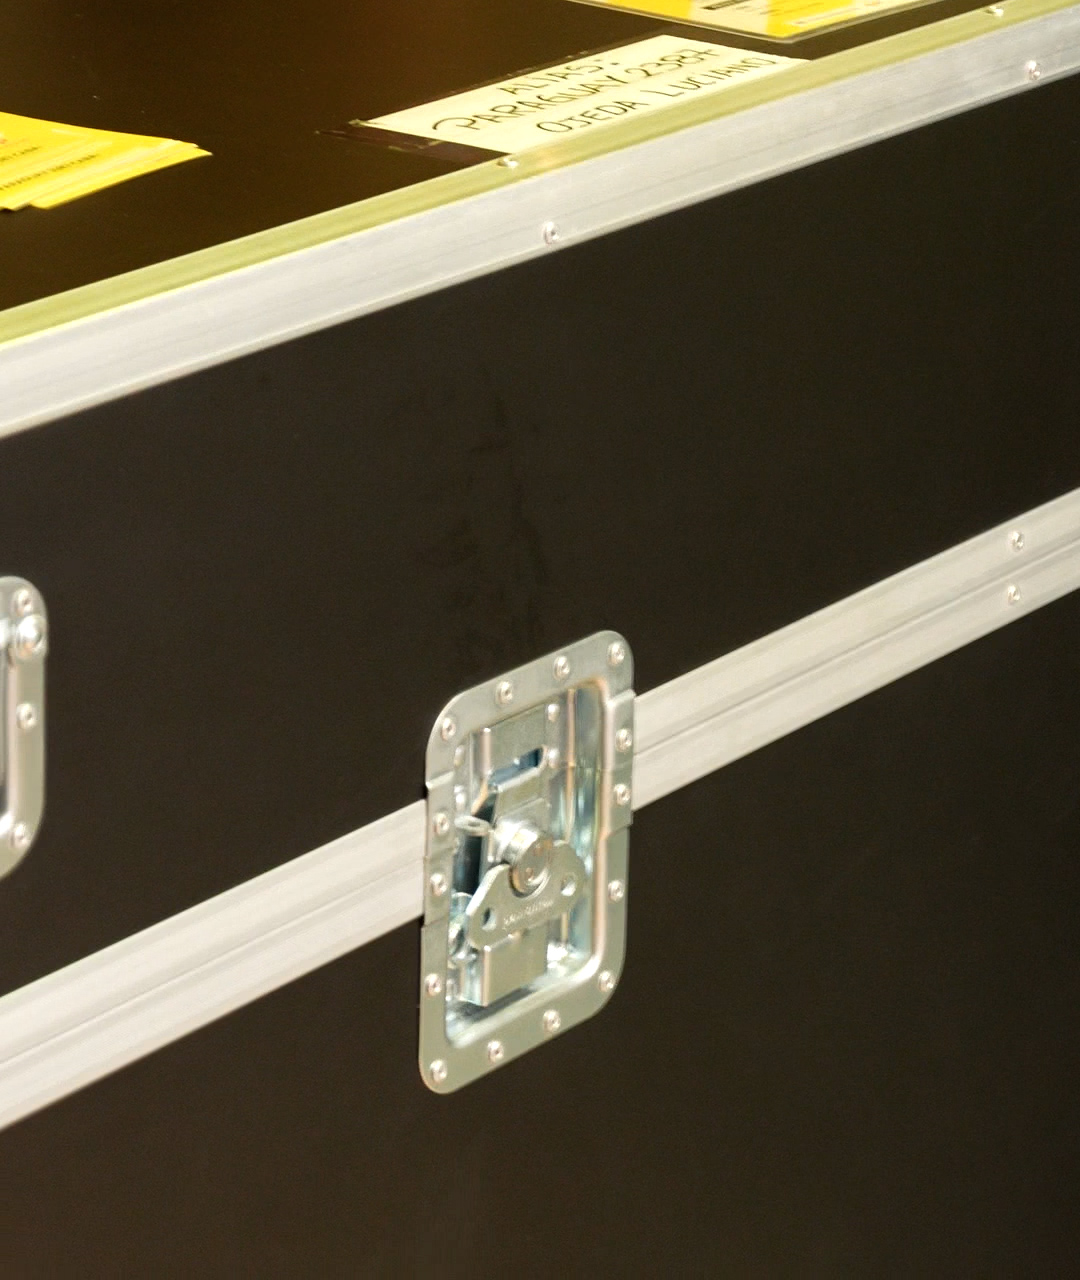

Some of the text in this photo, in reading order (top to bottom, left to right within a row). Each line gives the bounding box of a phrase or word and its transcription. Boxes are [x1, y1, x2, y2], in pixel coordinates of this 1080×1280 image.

[431, 48, 720, 131] PARAGUAY 2387
[497, 59, 619, 95] ALIAS:
[536, 57, 777, 133] OJEDA LUCIANO
